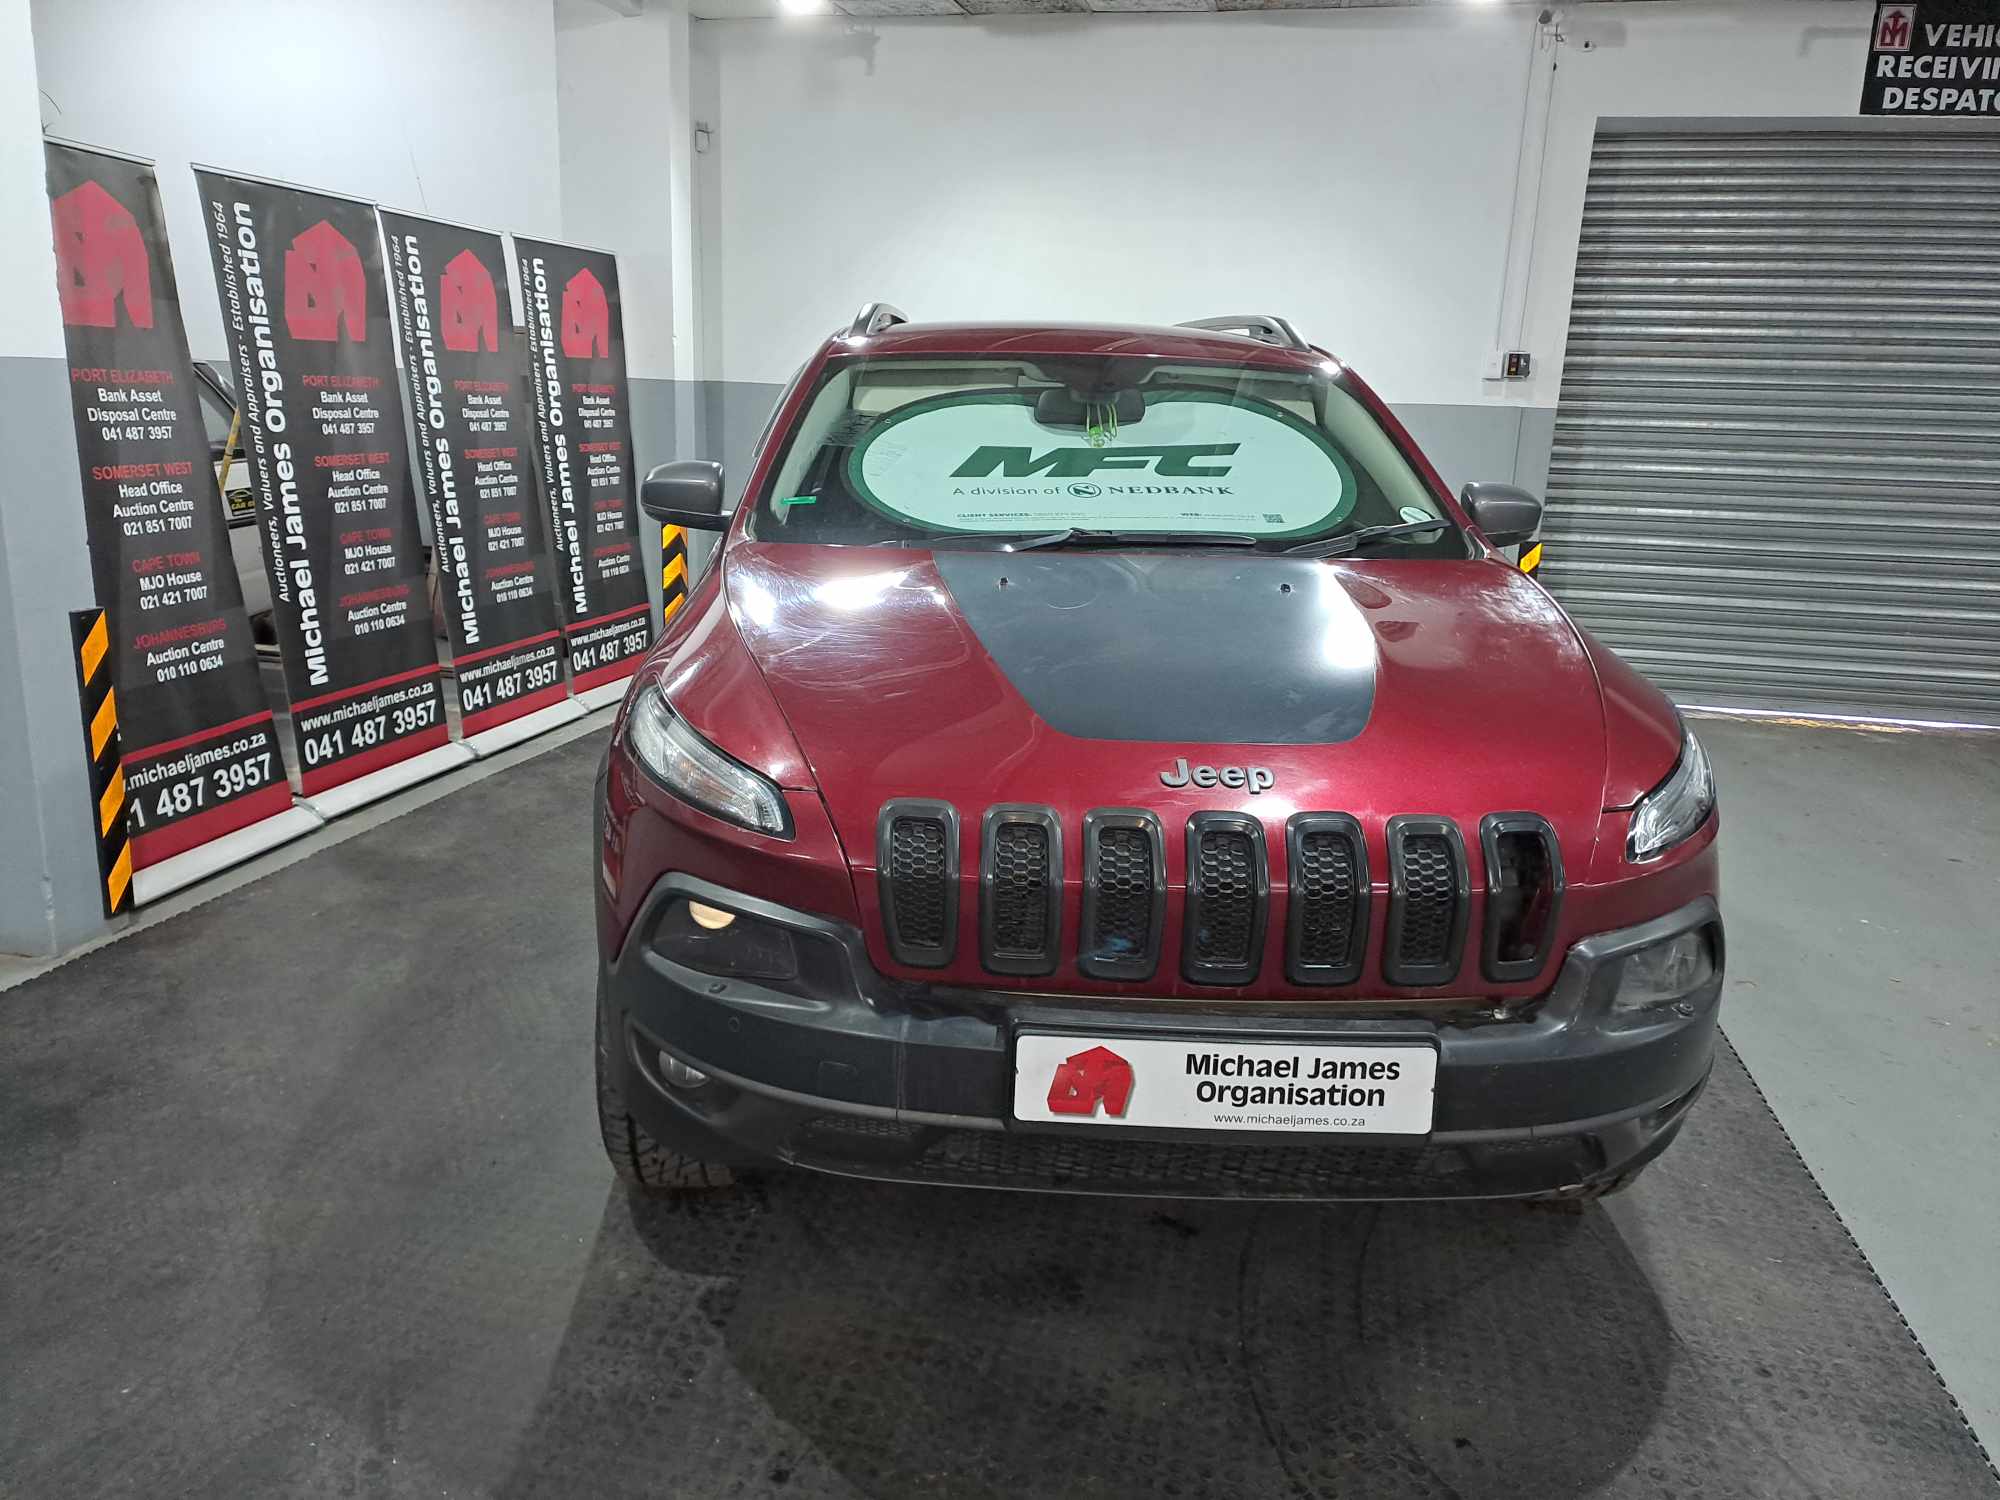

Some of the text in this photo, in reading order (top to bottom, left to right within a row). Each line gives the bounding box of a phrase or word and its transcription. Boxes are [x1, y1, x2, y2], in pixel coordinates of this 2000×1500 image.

[212, 200, 228, 239] 1964
[218, 243, 244, 332] Established
[396, 270, 414, 343] Established
[71, 368, 108, 383] PORT
[238, 343, 261, 422] Appraisers
[409, 354, 426, 420] Appraisers
[97, 388, 163, 402] Bank Asset
[320, 391, 344, 403] Bank
[87, 407, 177, 424] Disposal Centre
[312, 407, 380, 422] Disposal Centre
[102, 426, 172, 441] 041 487 3957
[250, 425, 265, 454] and
[321, 423, 338, 435] 041
[340, 423, 355, 434] 487
[405, 235, 479, 644] Michael James Organisation
[418, 422, 430, 447] and
[533, 258, 588, 613] Michael James Organisation
[538, 420, 549, 442] and
[233, 201, 329, 686] Michael James Organisation
[92, 461, 193, 480] SOMERSET WEST
[424, 450, 438, 495] Valuers
[543, 444, 555, 484] Valuers
[949, 443, 1241, 477] MFC
[258, 457, 274, 511] Valuers
[332, 468, 381, 482] Head Office
[118, 480, 183, 498] Head Office
[327, 484, 389, 498] Auction Centre
[952, 486, 1234, 496] A division of NEDBANK
[113, 499, 194, 518] Auction Centre
[334, 501, 350, 514] 021
[123, 516, 192, 536] 021 851 7007
[268, 516, 290, 602] Auctioneers,
[344, 544, 392, 560] MJO House
[139, 571, 202, 591] MJO House
[344, 562, 360, 575] 021
[361, 560, 376, 573] 421
[140, 586, 208, 610] 021 421 7007
[347, 600, 407, 622] Auction Centre
[354, 622, 370, 636] 010
[371, 618, 385, 632] 110
[570, 617, 646, 647] www.michaeljames.co.za
[146, 638, 225, 666] Auction Centre
[460, 646, 555, 683] www.michaeljames.co.za
[573, 630, 647, 672] 041 487 3957
[156, 654, 224, 683] 010 110 0634
[463, 660, 557, 711] 041 487 3957
[301, 682, 434, 732] www.michaeljames.co.za
[304, 699, 436, 765] 041 487 3957
[123, 732, 267, 792] .michaeljames.co.za
[1160, 758, 1275, 795] Jeep
[126, 752, 271, 834] 1 487 3957
[1185, 1053, 1400, 1080] Michael James
[1196, 1081, 1385, 1107] Organisation
[1213, 1112, 1366, 1128] www.michaeljames.co.za
